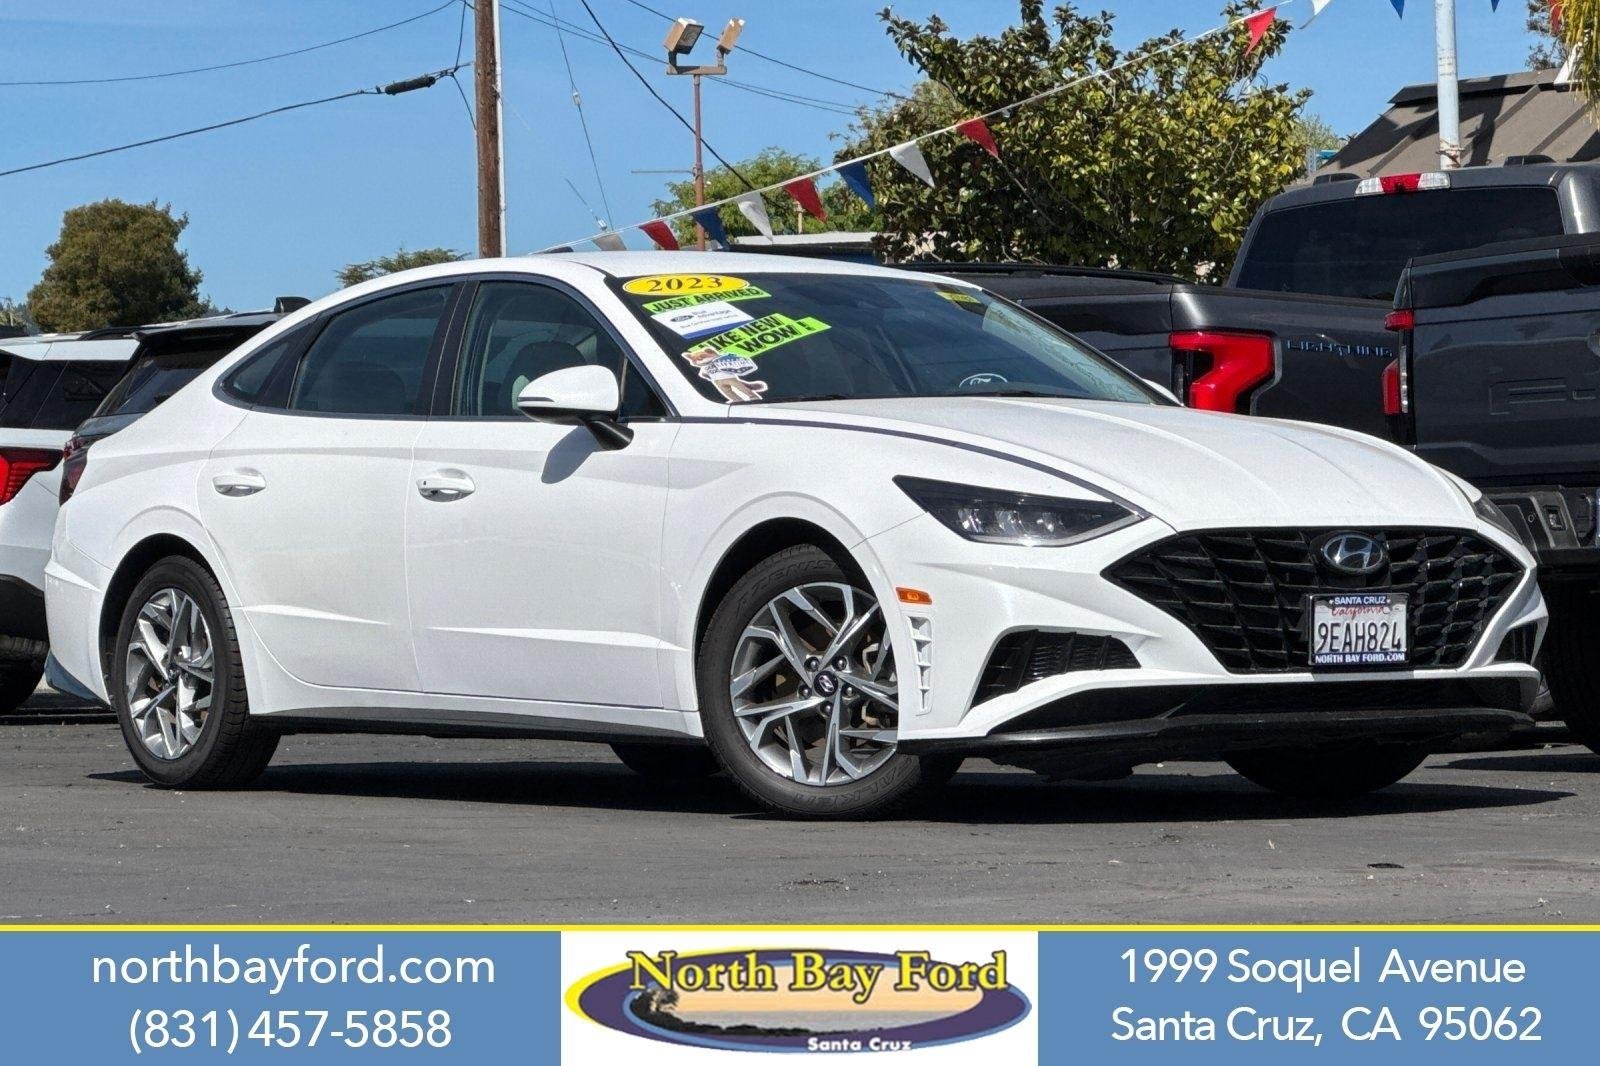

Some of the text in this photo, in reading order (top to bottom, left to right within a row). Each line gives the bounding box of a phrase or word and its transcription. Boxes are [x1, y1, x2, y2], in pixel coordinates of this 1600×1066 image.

[646, 277, 723, 293] 2023
[652, 287, 764, 312] JUST ARRIVED
[740, 314, 786, 338] NEW
[735, 324, 800, 353] WOW
[1334, 596, 1387, 605] SANTA CRUZ
[1316, 621, 1402, 653] 9EAH824
[1315, 652, 1405, 663] NORTH BAY FORD.COM
